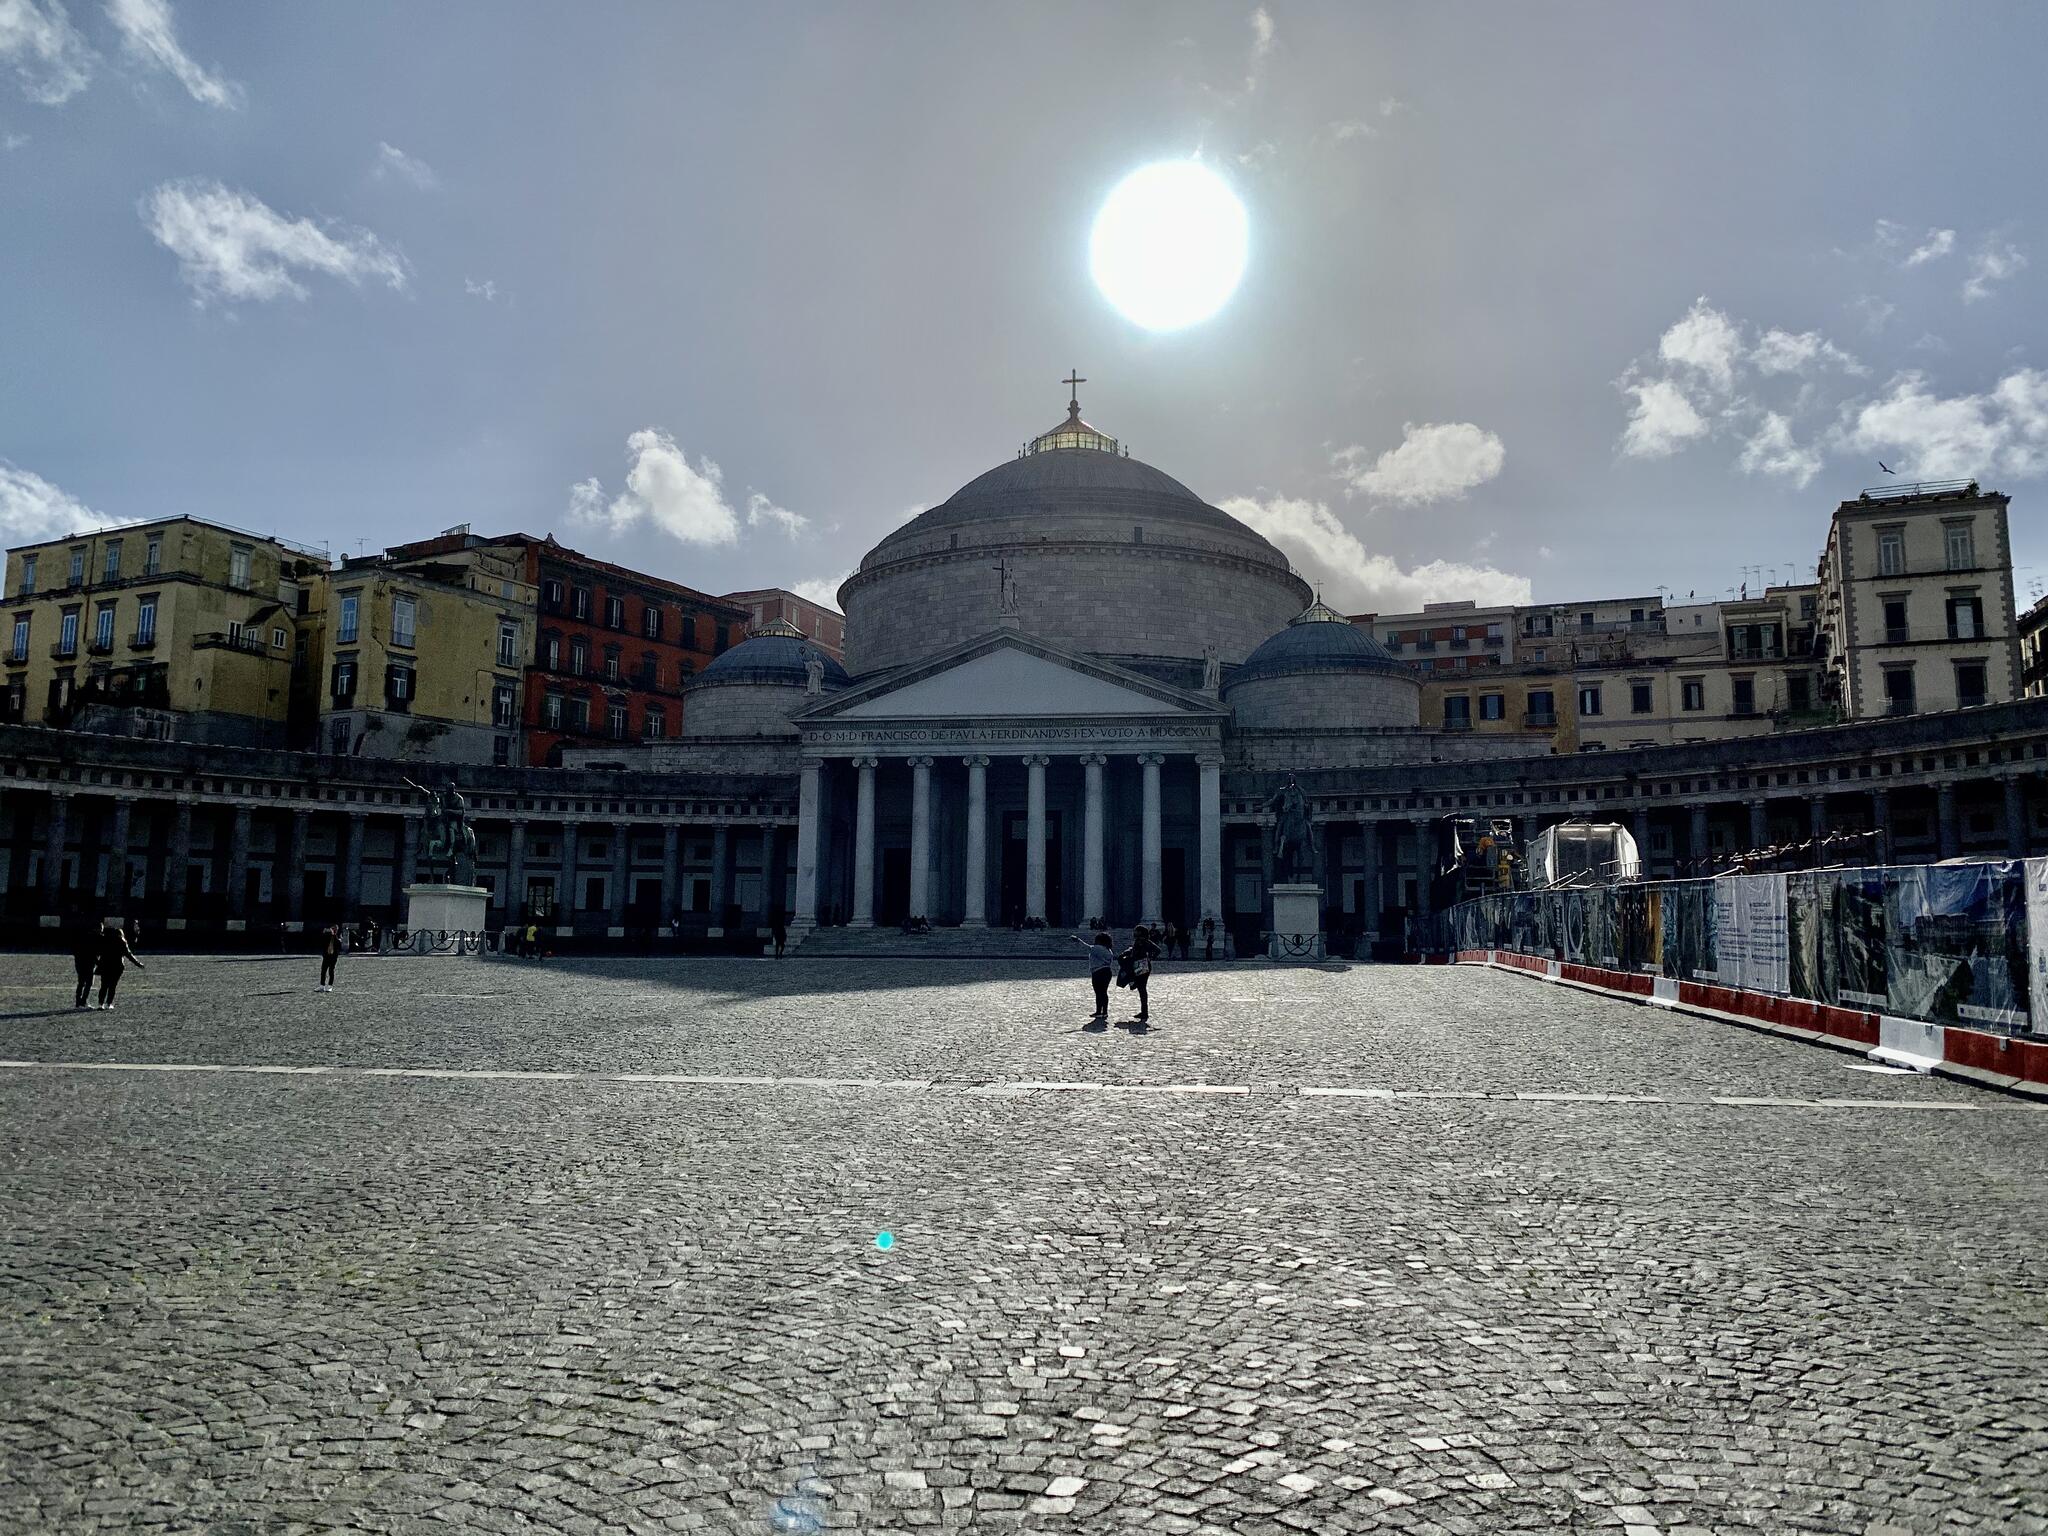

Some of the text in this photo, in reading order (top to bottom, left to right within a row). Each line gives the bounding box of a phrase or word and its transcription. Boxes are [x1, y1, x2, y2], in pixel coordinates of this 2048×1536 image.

[861, 730, 927, 741] FRANCISCO
[931, 730, 946, 740] DE
[950, 729, 986, 739] PAVLA
[991, 728, 1070, 739] FERDINANDVS
[1081, 728, 1095, 738] EX
[1100, 727, 1133, 738] VOTO
[1150, 726, 1211, 737] MDCCCXVI
